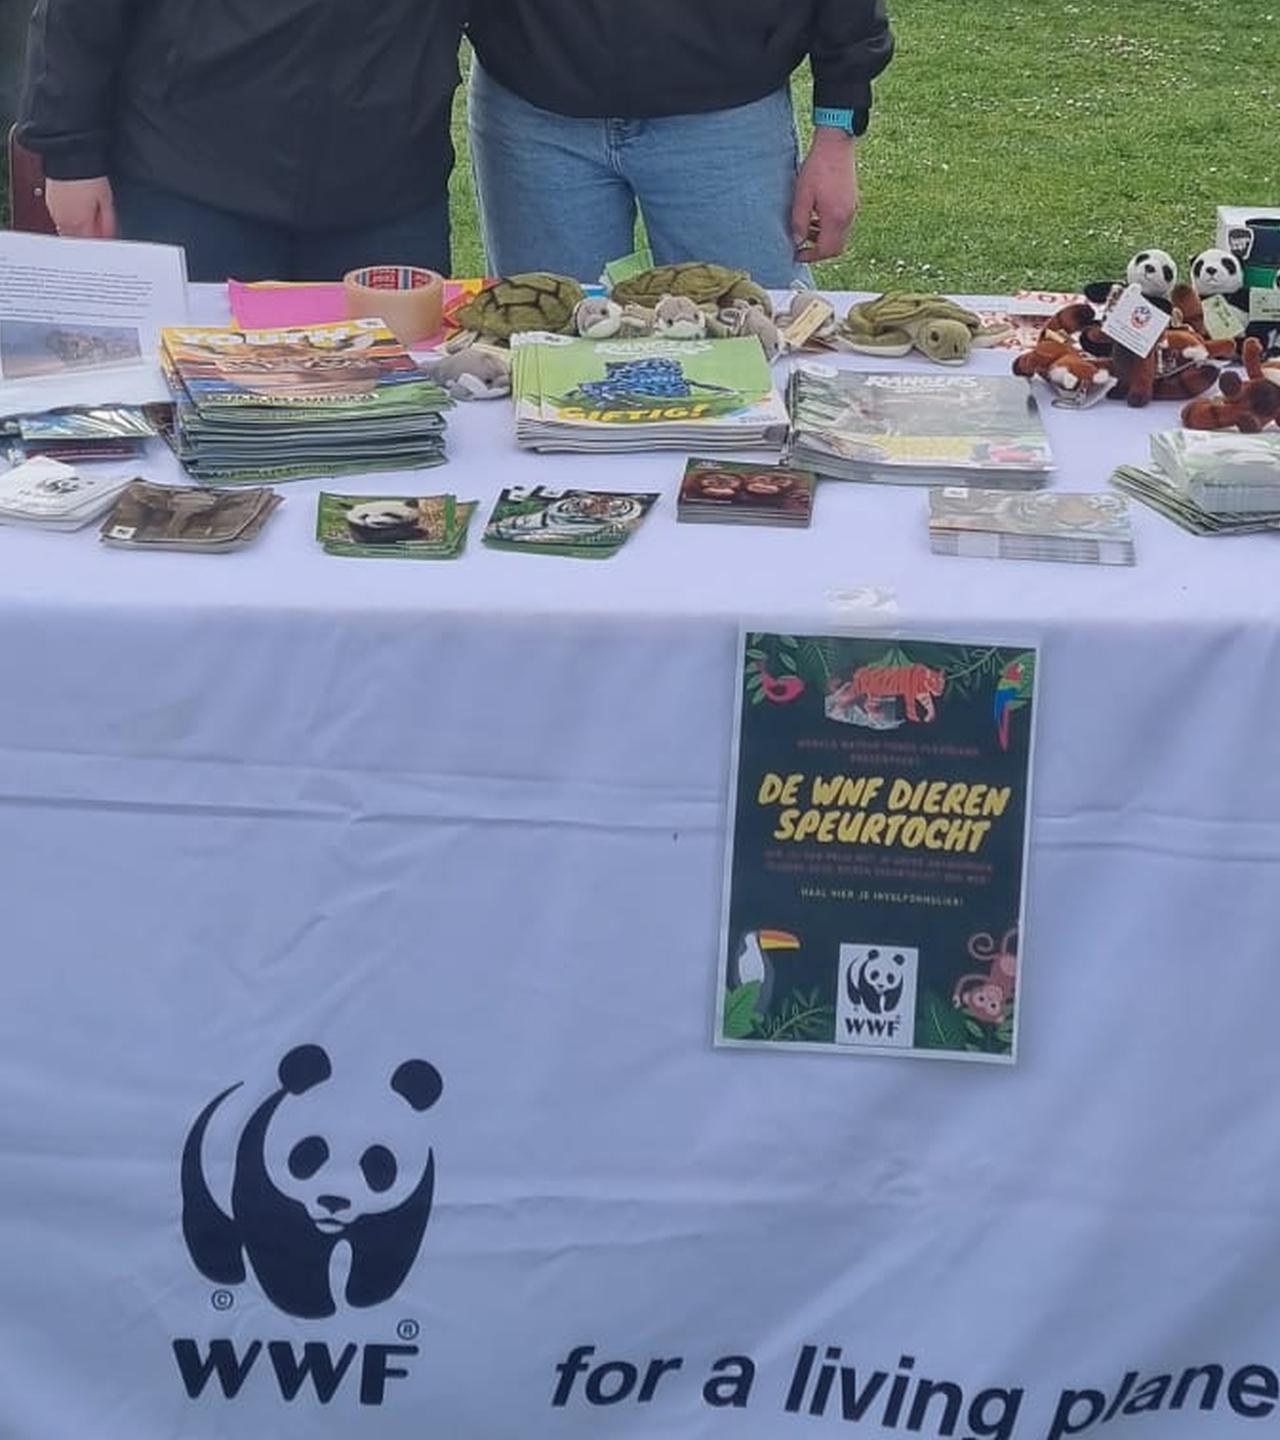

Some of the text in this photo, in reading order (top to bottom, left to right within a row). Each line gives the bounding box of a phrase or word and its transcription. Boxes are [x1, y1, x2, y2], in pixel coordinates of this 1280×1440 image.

[757, 773, 1011, 817] DE WNF DIEREN
[773, 809, 991, 853] SPEURTOCHT
[844, 1017, 901, 1037] WWF
[172, 1338, 419, 1405] WWF
[552, 1346, 682, 1408] for
[703, 1355, 754, 1408] a
[784, 1346, 1025, 1440] living
